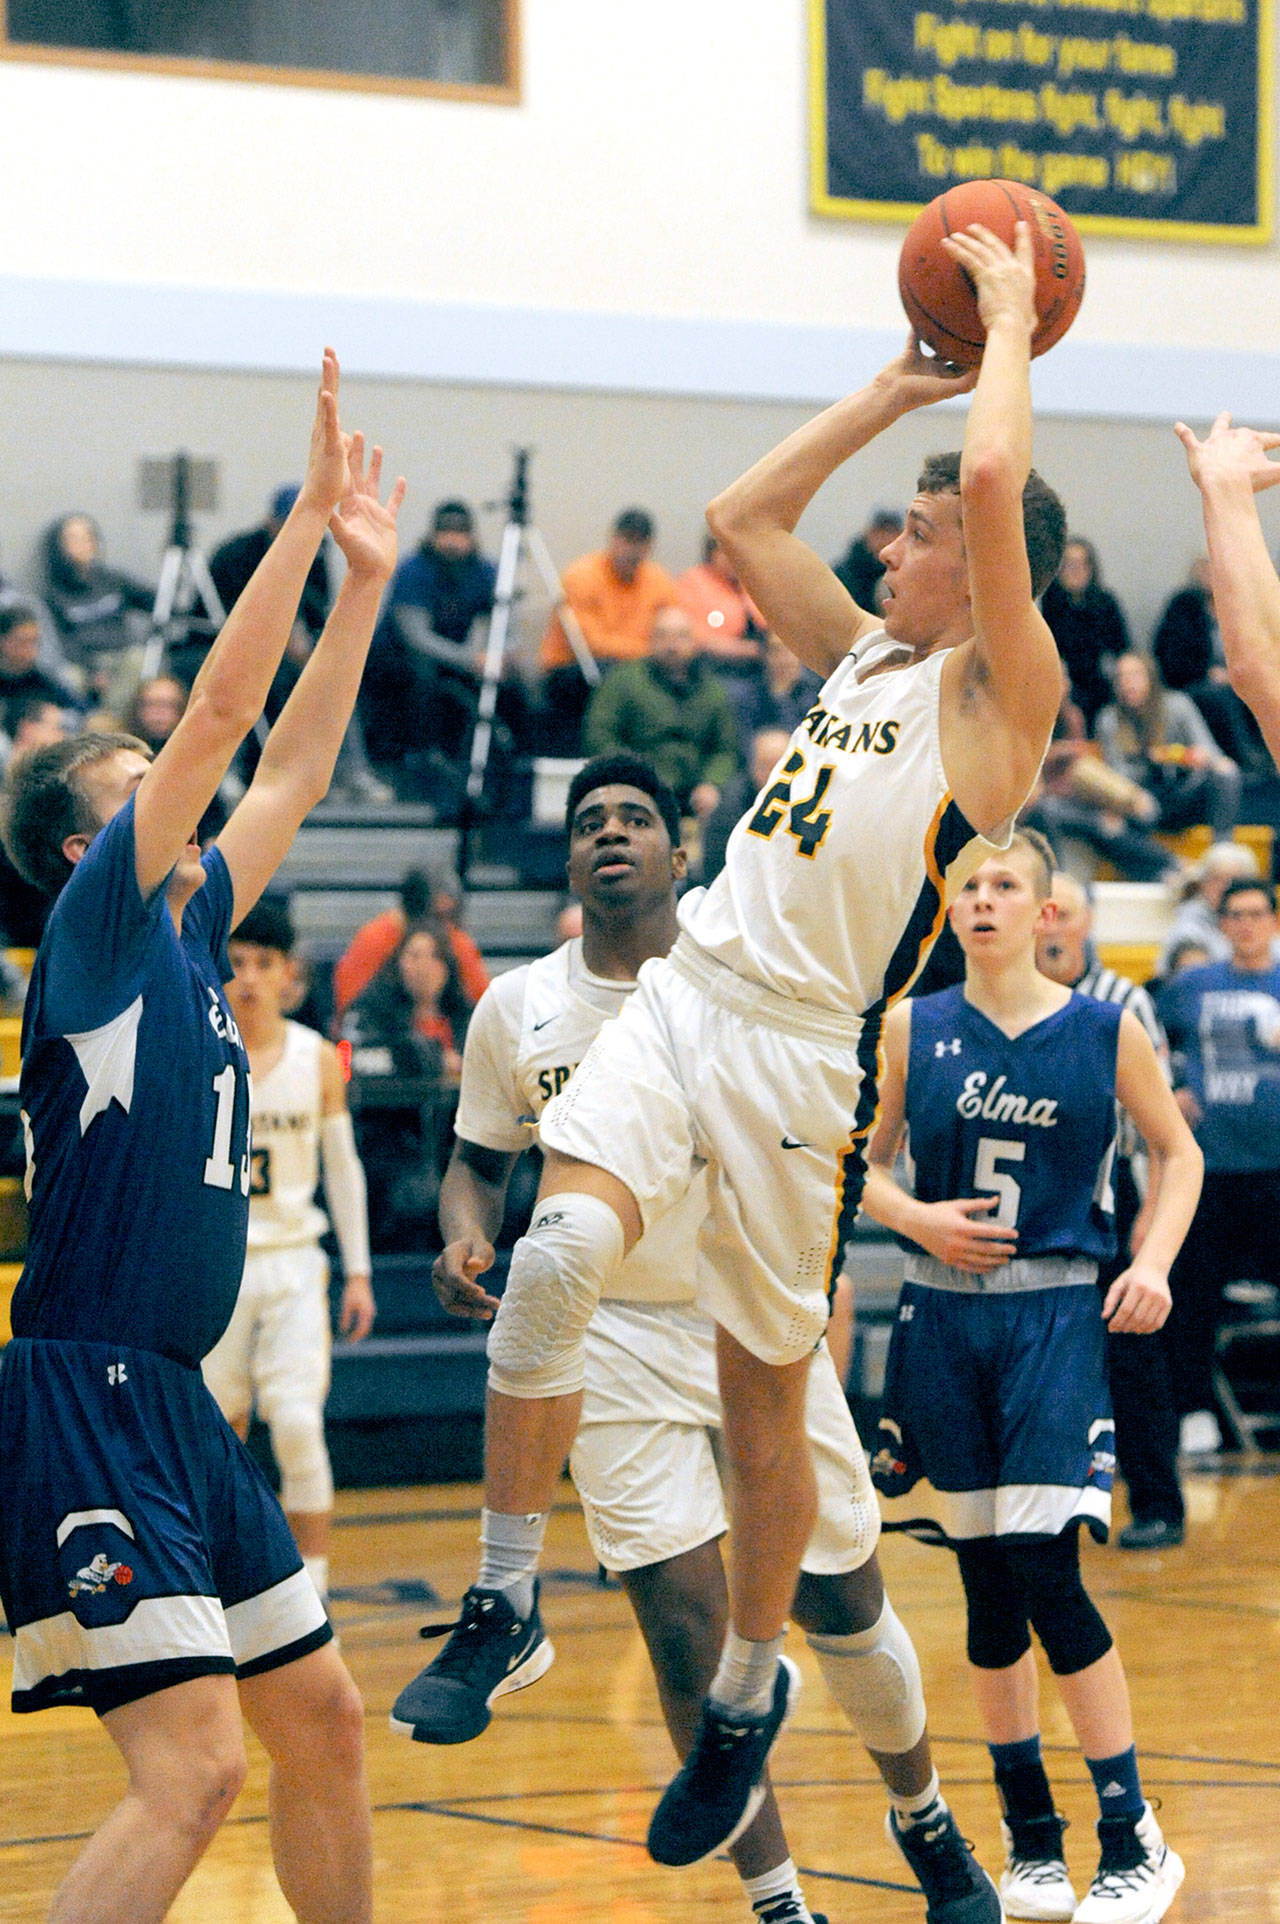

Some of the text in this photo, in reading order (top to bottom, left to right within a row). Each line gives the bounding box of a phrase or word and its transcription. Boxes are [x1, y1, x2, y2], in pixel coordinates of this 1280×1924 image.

[746, 747, 836, 860] 24
[956, 1071, 1059, 1127] Elma
[973, 1137, 1026, 1230] 5
